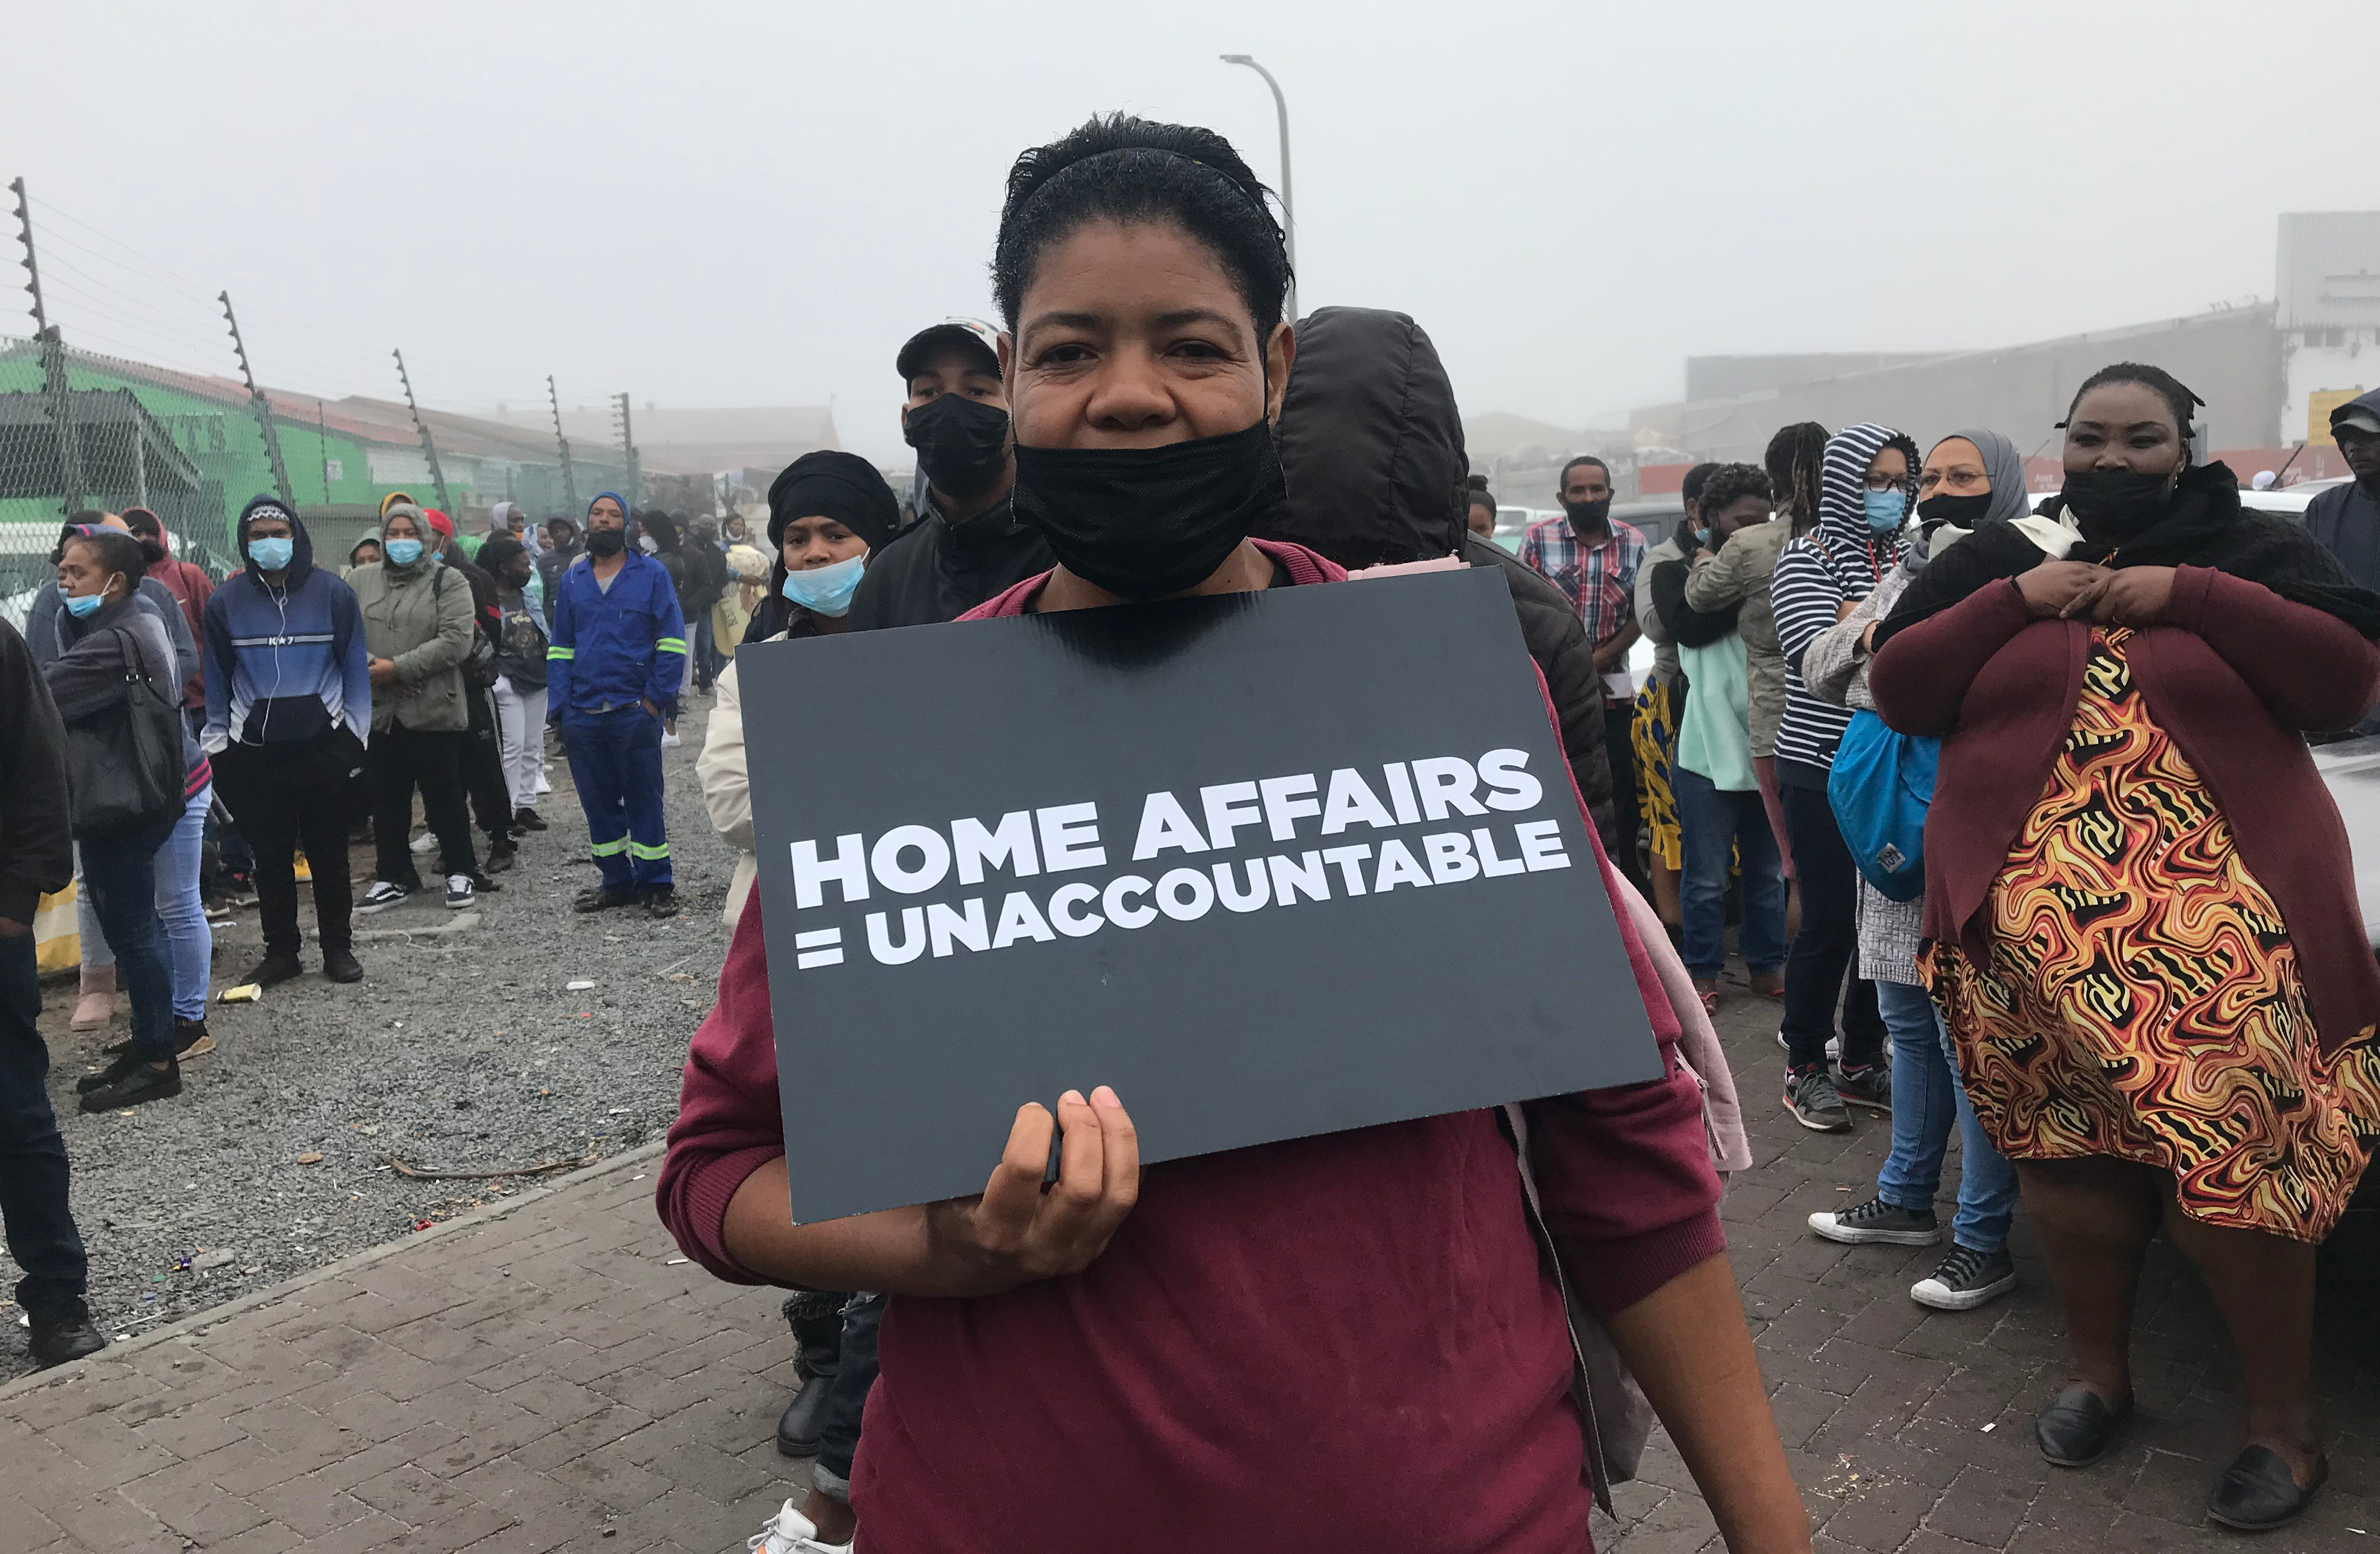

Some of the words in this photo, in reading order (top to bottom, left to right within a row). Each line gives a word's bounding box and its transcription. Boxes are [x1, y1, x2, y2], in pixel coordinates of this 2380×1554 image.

[790, 802, 1107, 909] HOME
[1132, 749, 1542, 860] AFFAIRS
[795, 928, 844, 969] =
[865, 820, 1571, 964] UNACCOUNTABLE
